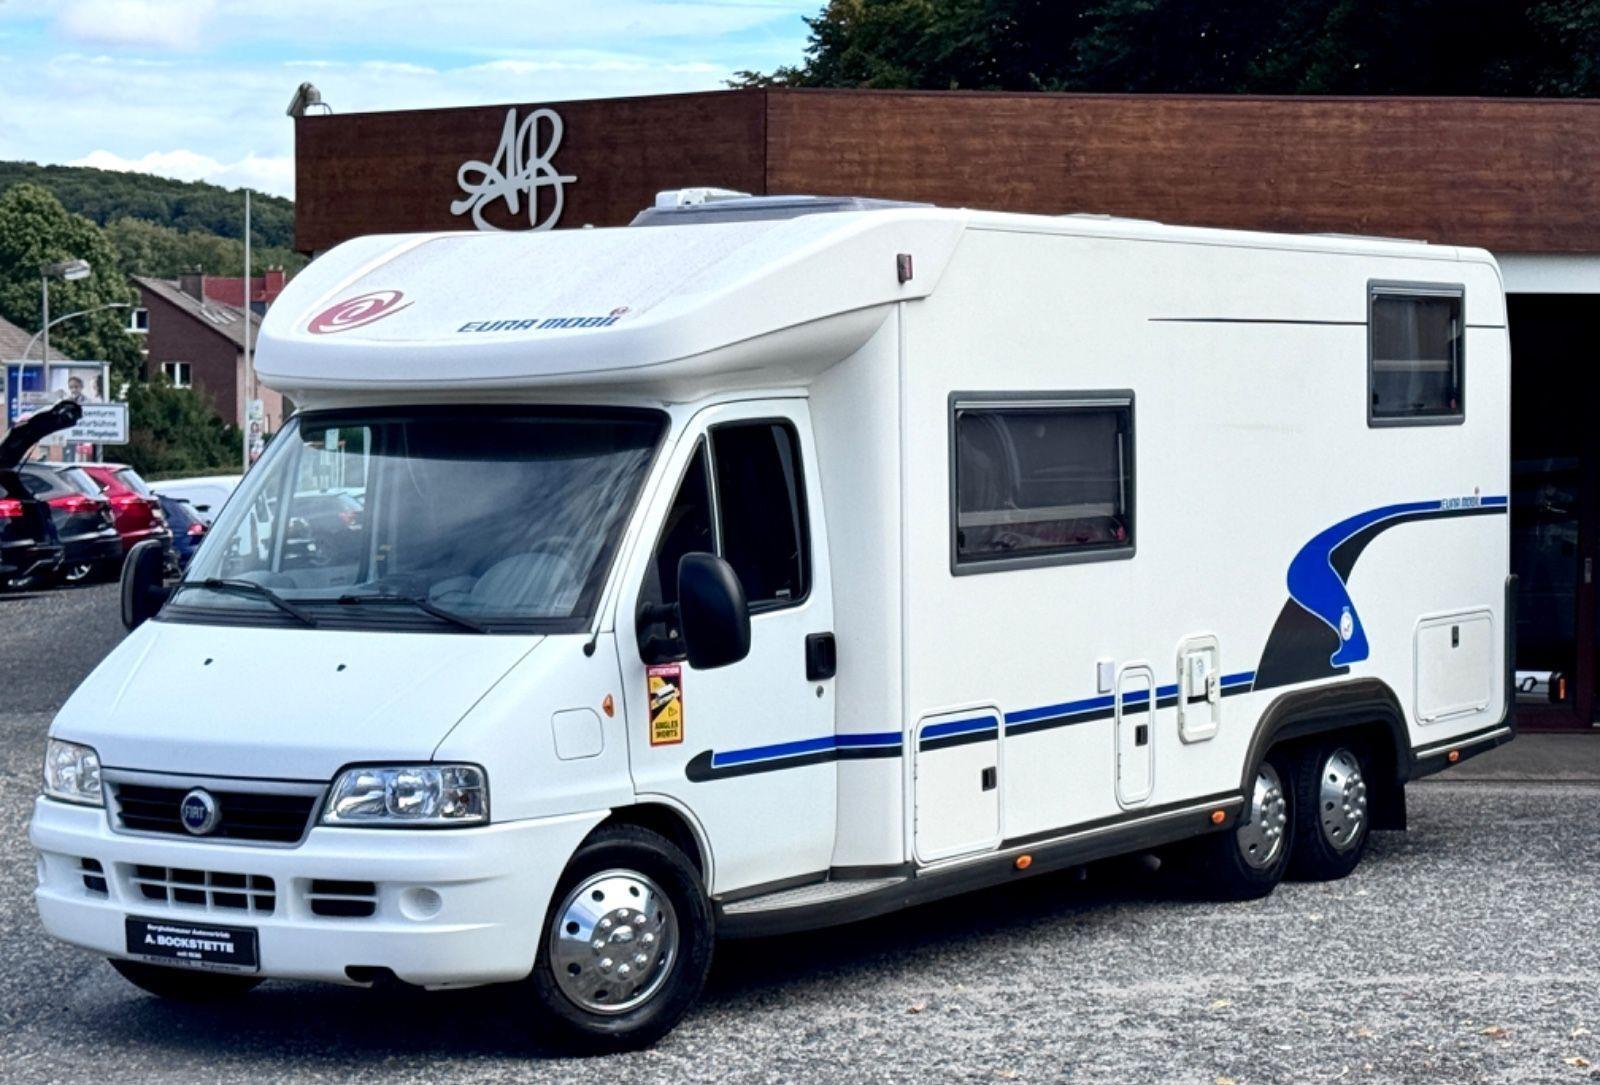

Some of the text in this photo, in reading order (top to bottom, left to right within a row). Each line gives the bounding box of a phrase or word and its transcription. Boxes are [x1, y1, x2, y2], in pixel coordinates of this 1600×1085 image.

[457, 312, 626, 333] EURA MOBIL
[83, 410, 116, 418] senturm
[655, 721, 679, 730] ANGLES
[656, 730, 678, 739] MORTS
[185, 805, 205, 819] FIAT
[144, 934, 235, 953] A. BOCKSTETTE
